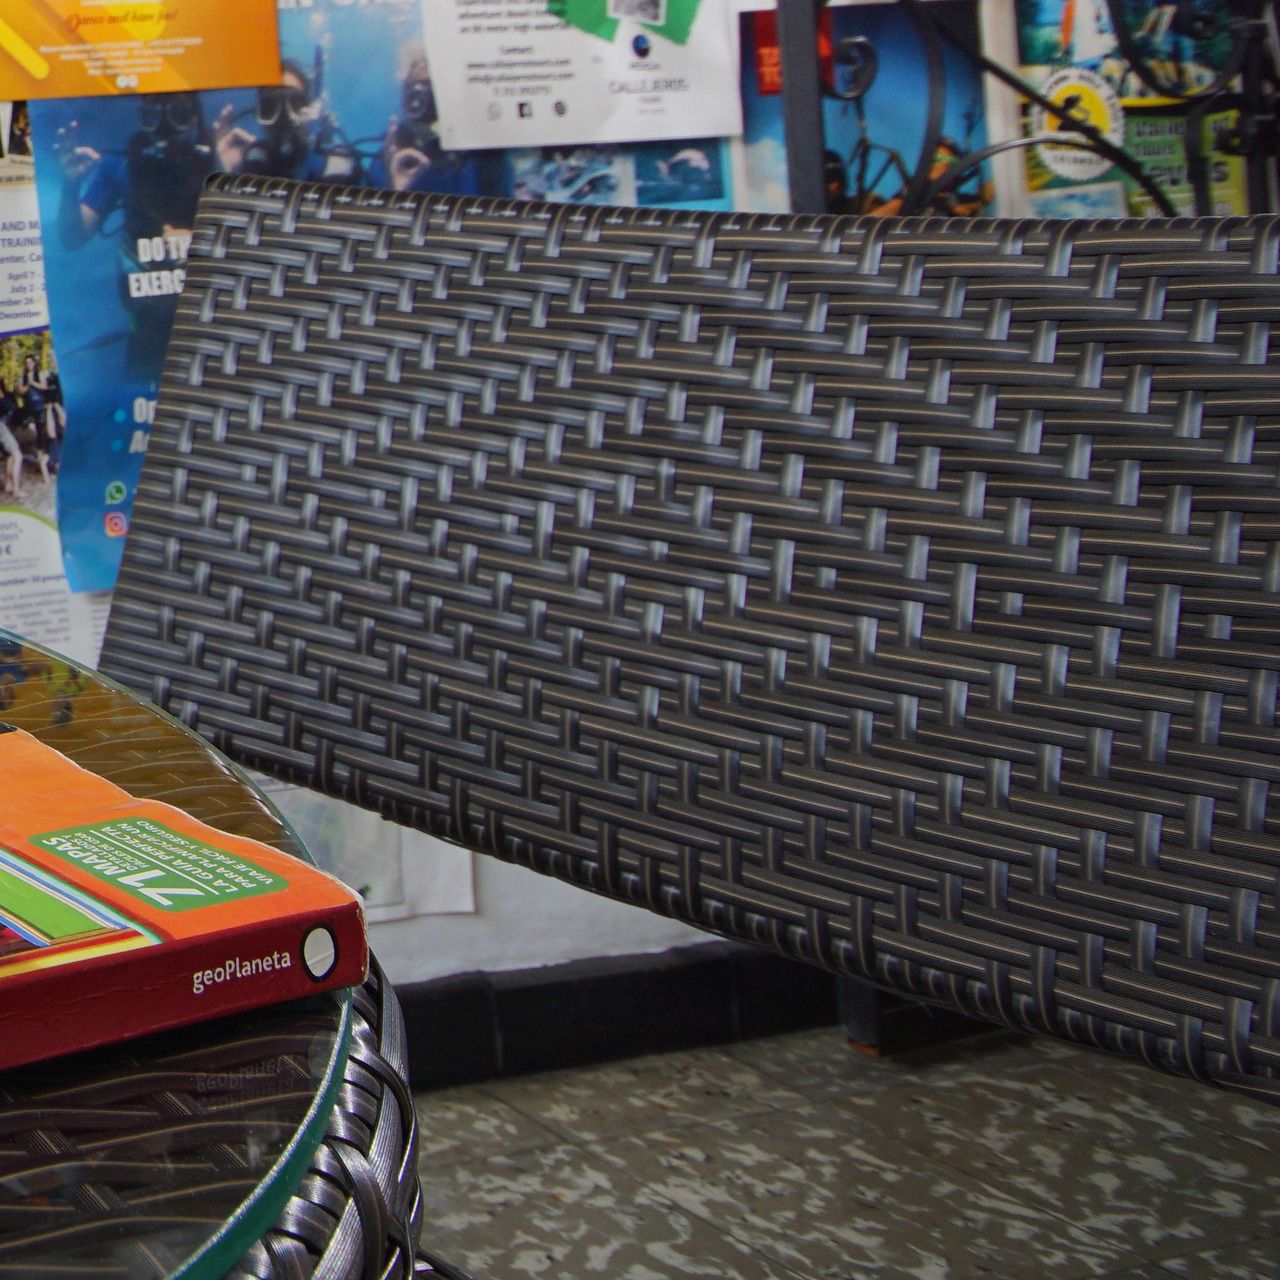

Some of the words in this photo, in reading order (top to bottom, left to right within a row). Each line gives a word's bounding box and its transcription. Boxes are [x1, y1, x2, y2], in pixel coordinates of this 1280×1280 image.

[42, 836, 128, 876] MAPAS
[131, 830, 215, 868] PLANIFICAR
[116, 870, 206, 907] 71
[218, 867, 257, 889] PARA
[190, 946, 294, 995] geoPlaneta
